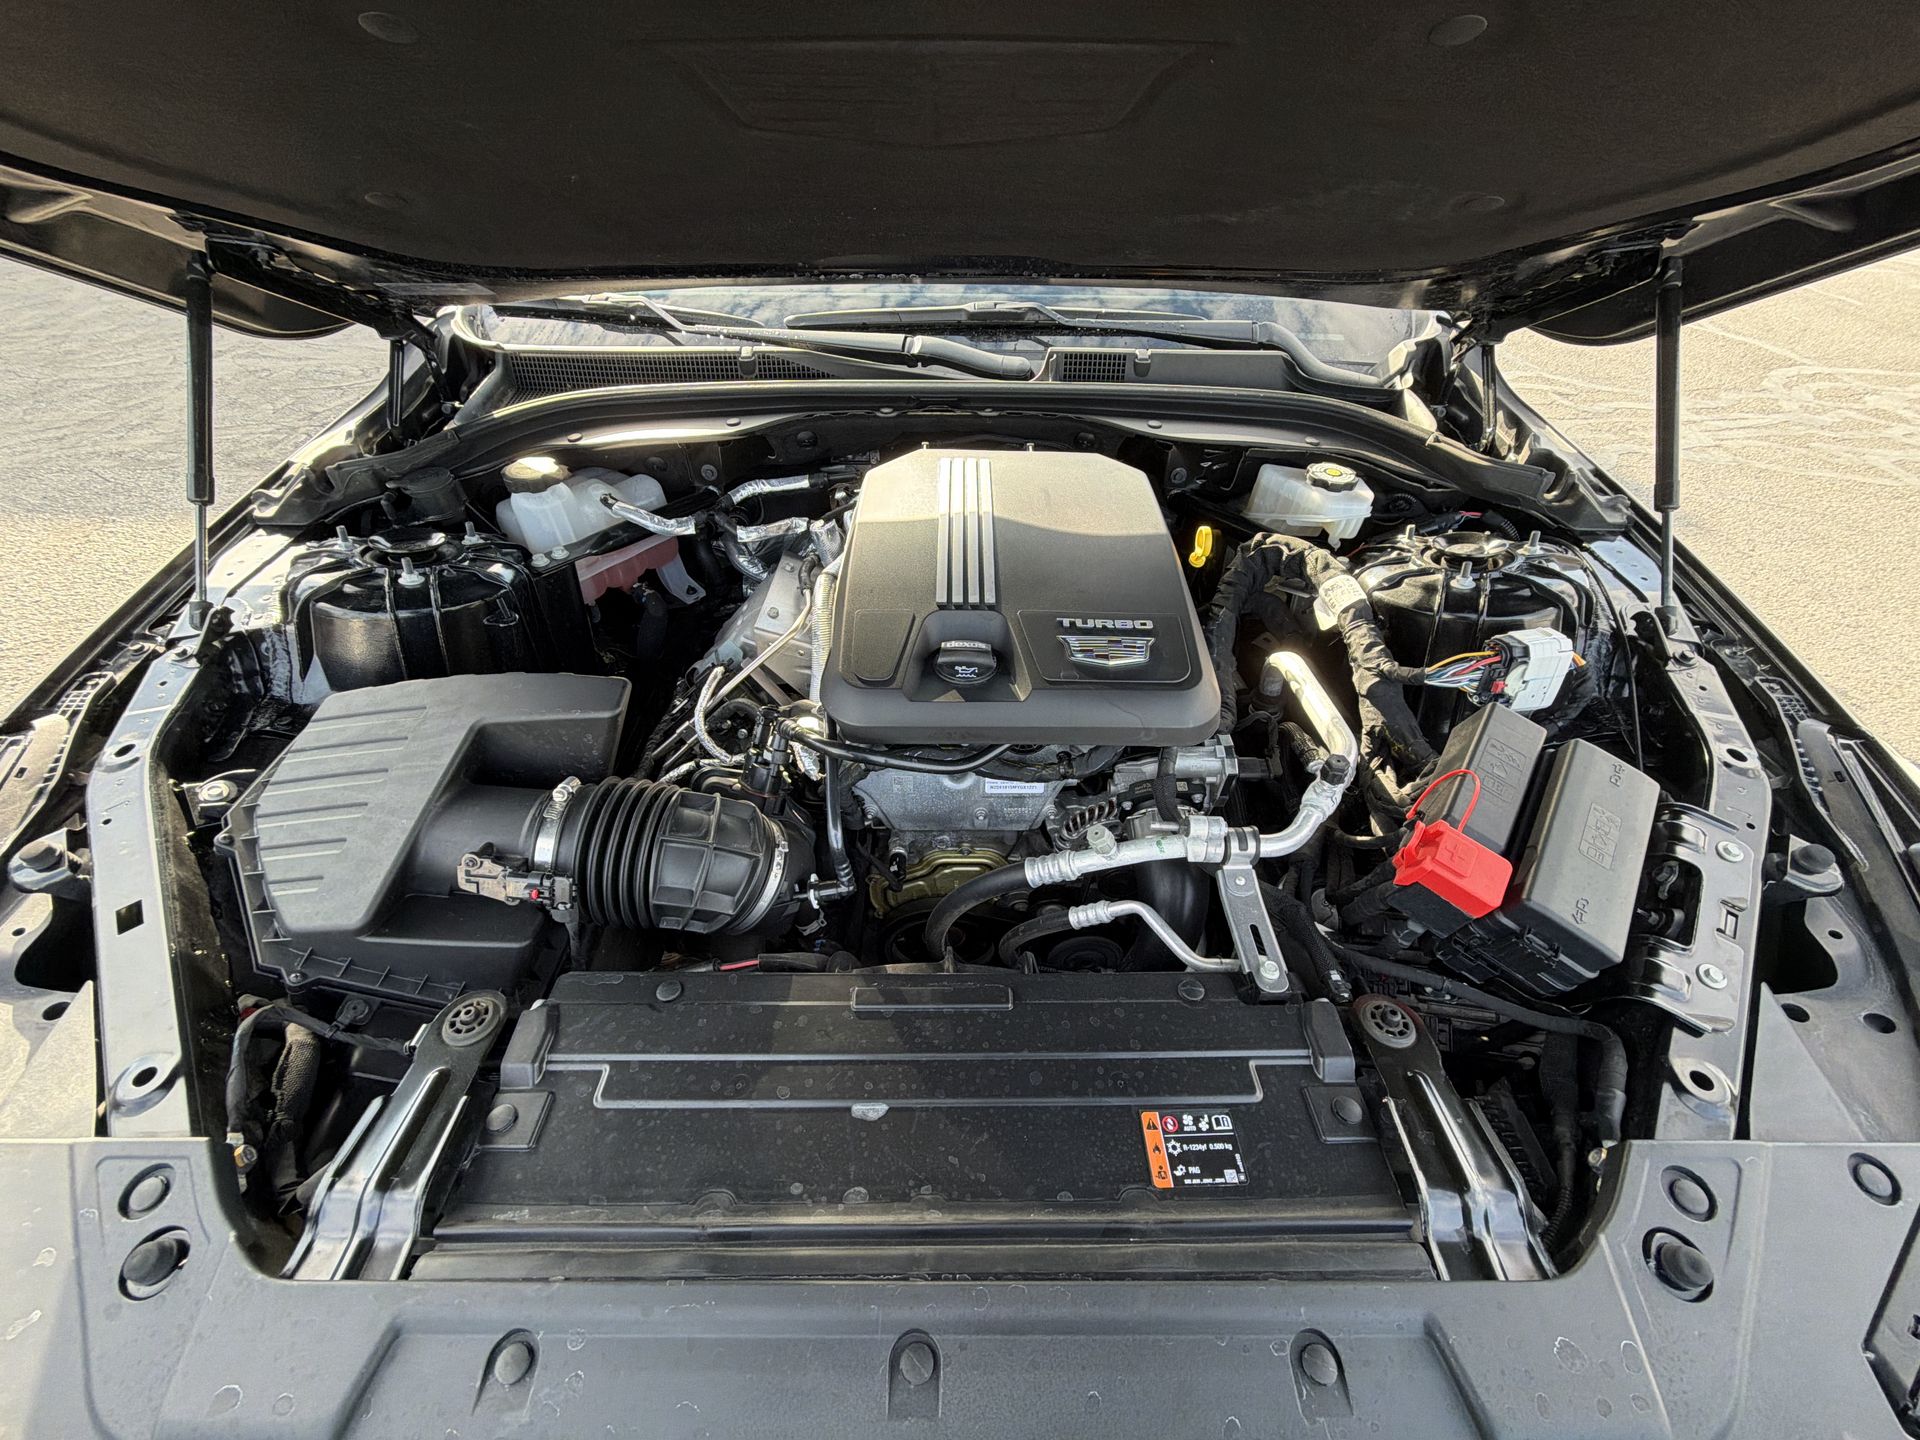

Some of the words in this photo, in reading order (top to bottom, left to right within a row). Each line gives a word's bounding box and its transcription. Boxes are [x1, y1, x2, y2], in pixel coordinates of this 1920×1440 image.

[1056, 617, 1154, 629] TURBO
[946, 641, 986, 649] dexos
[1225, 1143, 1233, 1151] kg
[1188, 1166, 1201, 1174] PAG
